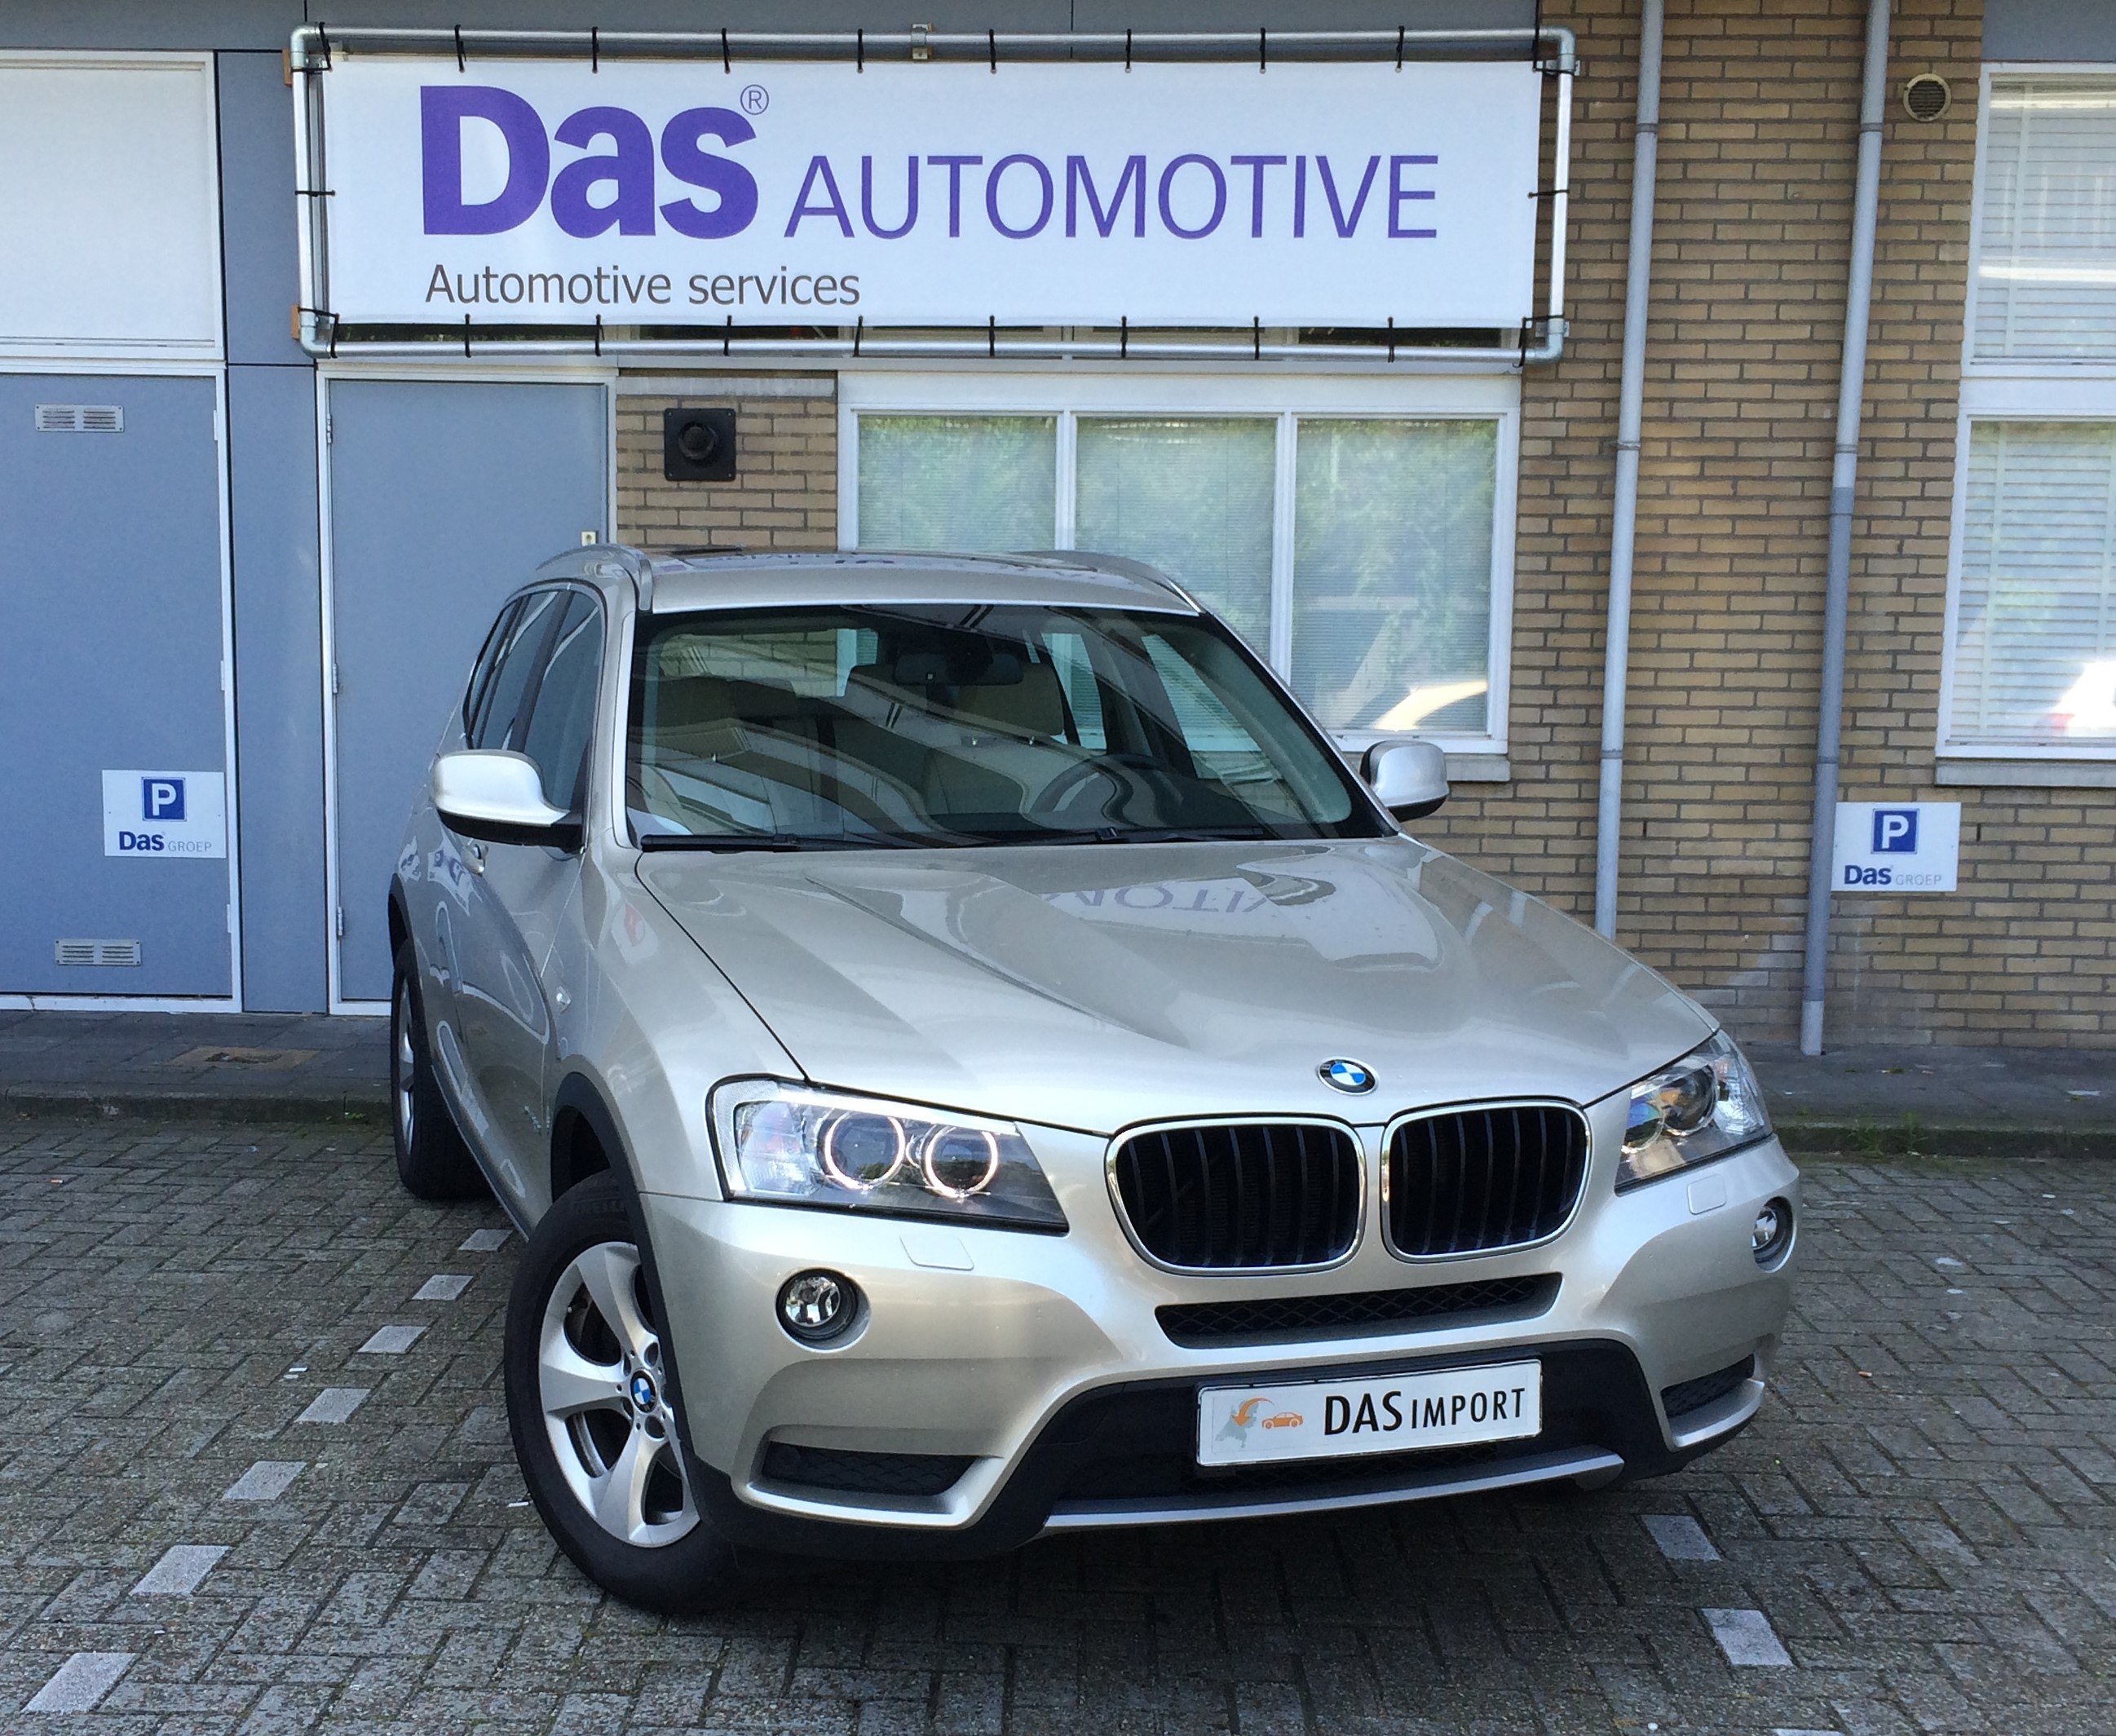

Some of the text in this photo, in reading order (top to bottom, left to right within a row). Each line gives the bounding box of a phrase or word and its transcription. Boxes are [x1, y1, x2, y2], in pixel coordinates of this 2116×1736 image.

[420, 85, 759, 240] Das
[784, 152, 1440, 240] AUTOMOTIVE
[425, 263, 860, 306] Automotive services
[151, 783, 177, 816] P
[118, 830, 213, 853] Das GROEP
[1881, 815, 1909, 849] P
[1844, 864, 1942, 886] Das GROEP
[1323, 1387, 1526, 1436] DAS IMPORT
